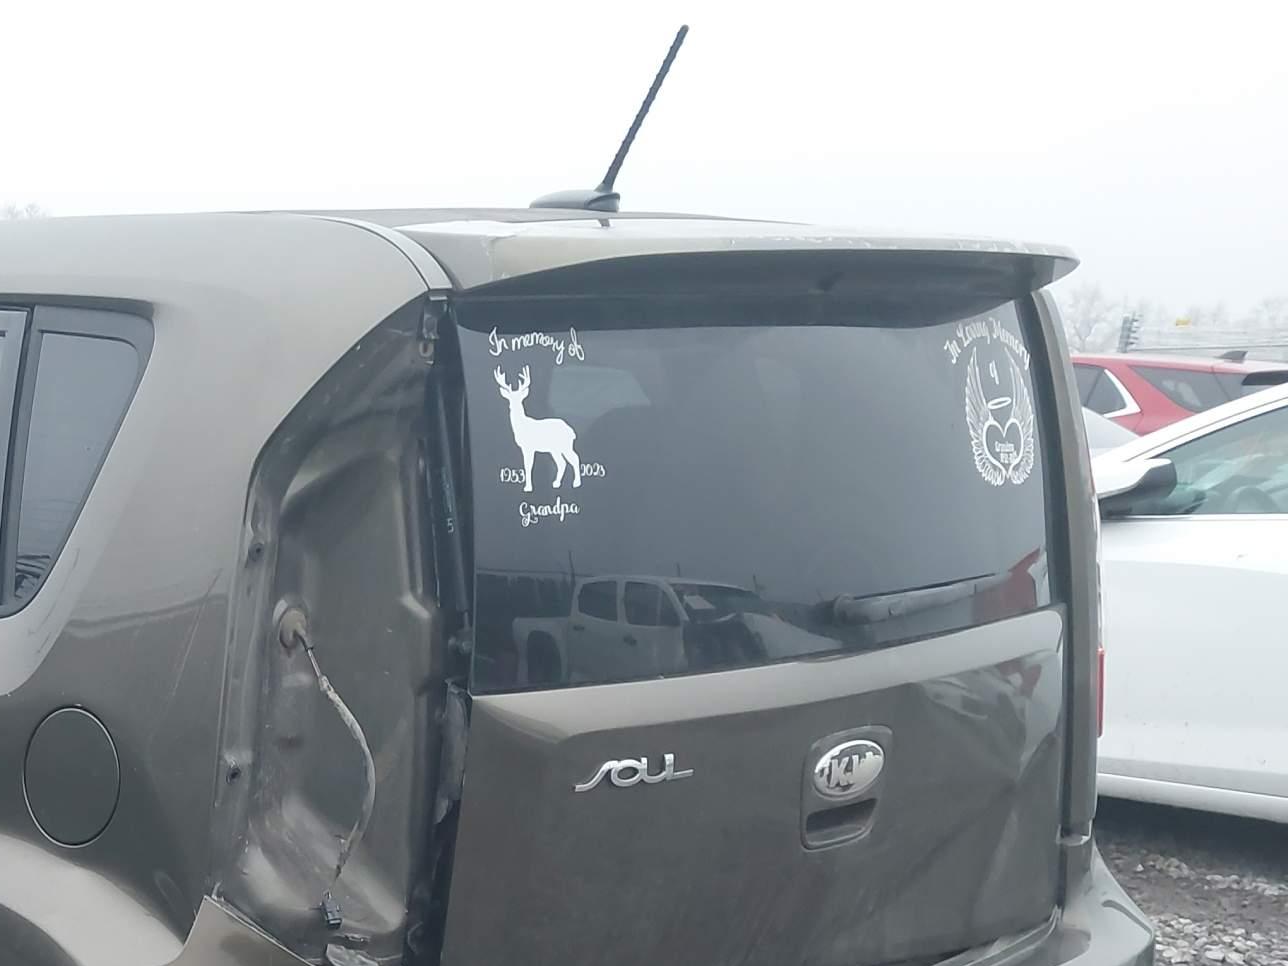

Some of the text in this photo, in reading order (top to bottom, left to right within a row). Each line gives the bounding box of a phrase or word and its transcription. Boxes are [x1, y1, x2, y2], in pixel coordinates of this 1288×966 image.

[488, 326, 585, 365] In memory of
[943, 339, 962, 365] In
[500, 467, 526, 484] 1953
[519, 496, 580, 527] Grandpa
[575, 753, 694, 792] SOUL
